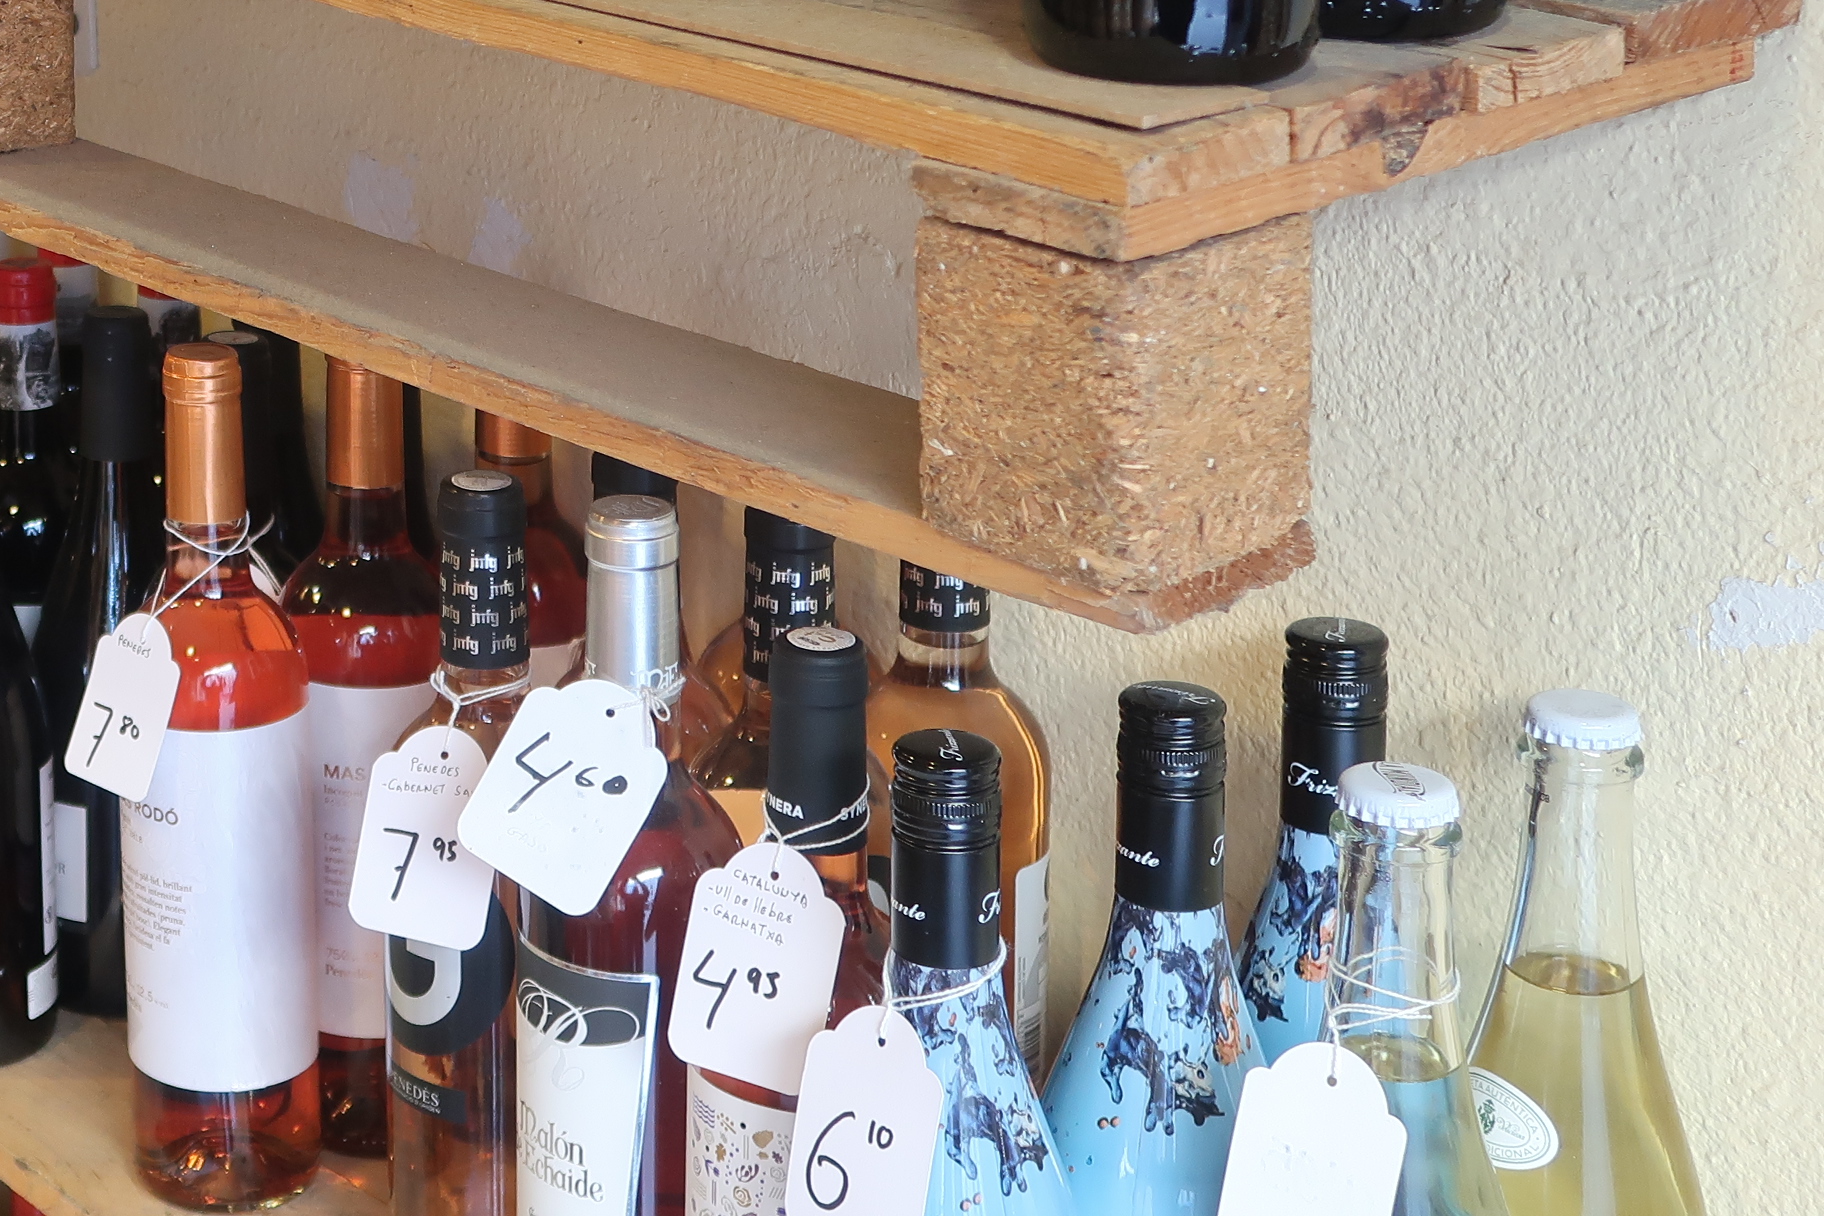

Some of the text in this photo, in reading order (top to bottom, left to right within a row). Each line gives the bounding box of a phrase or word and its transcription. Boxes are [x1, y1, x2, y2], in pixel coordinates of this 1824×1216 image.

[324, 764, 367, 781] MAS
[410, 757, 460, 777] PENEDES
[134, 802, 179, 826] RODÓ
[519, 1099, 586, 1167] Malón
[523, 1140, 604, 1203] Echaide
